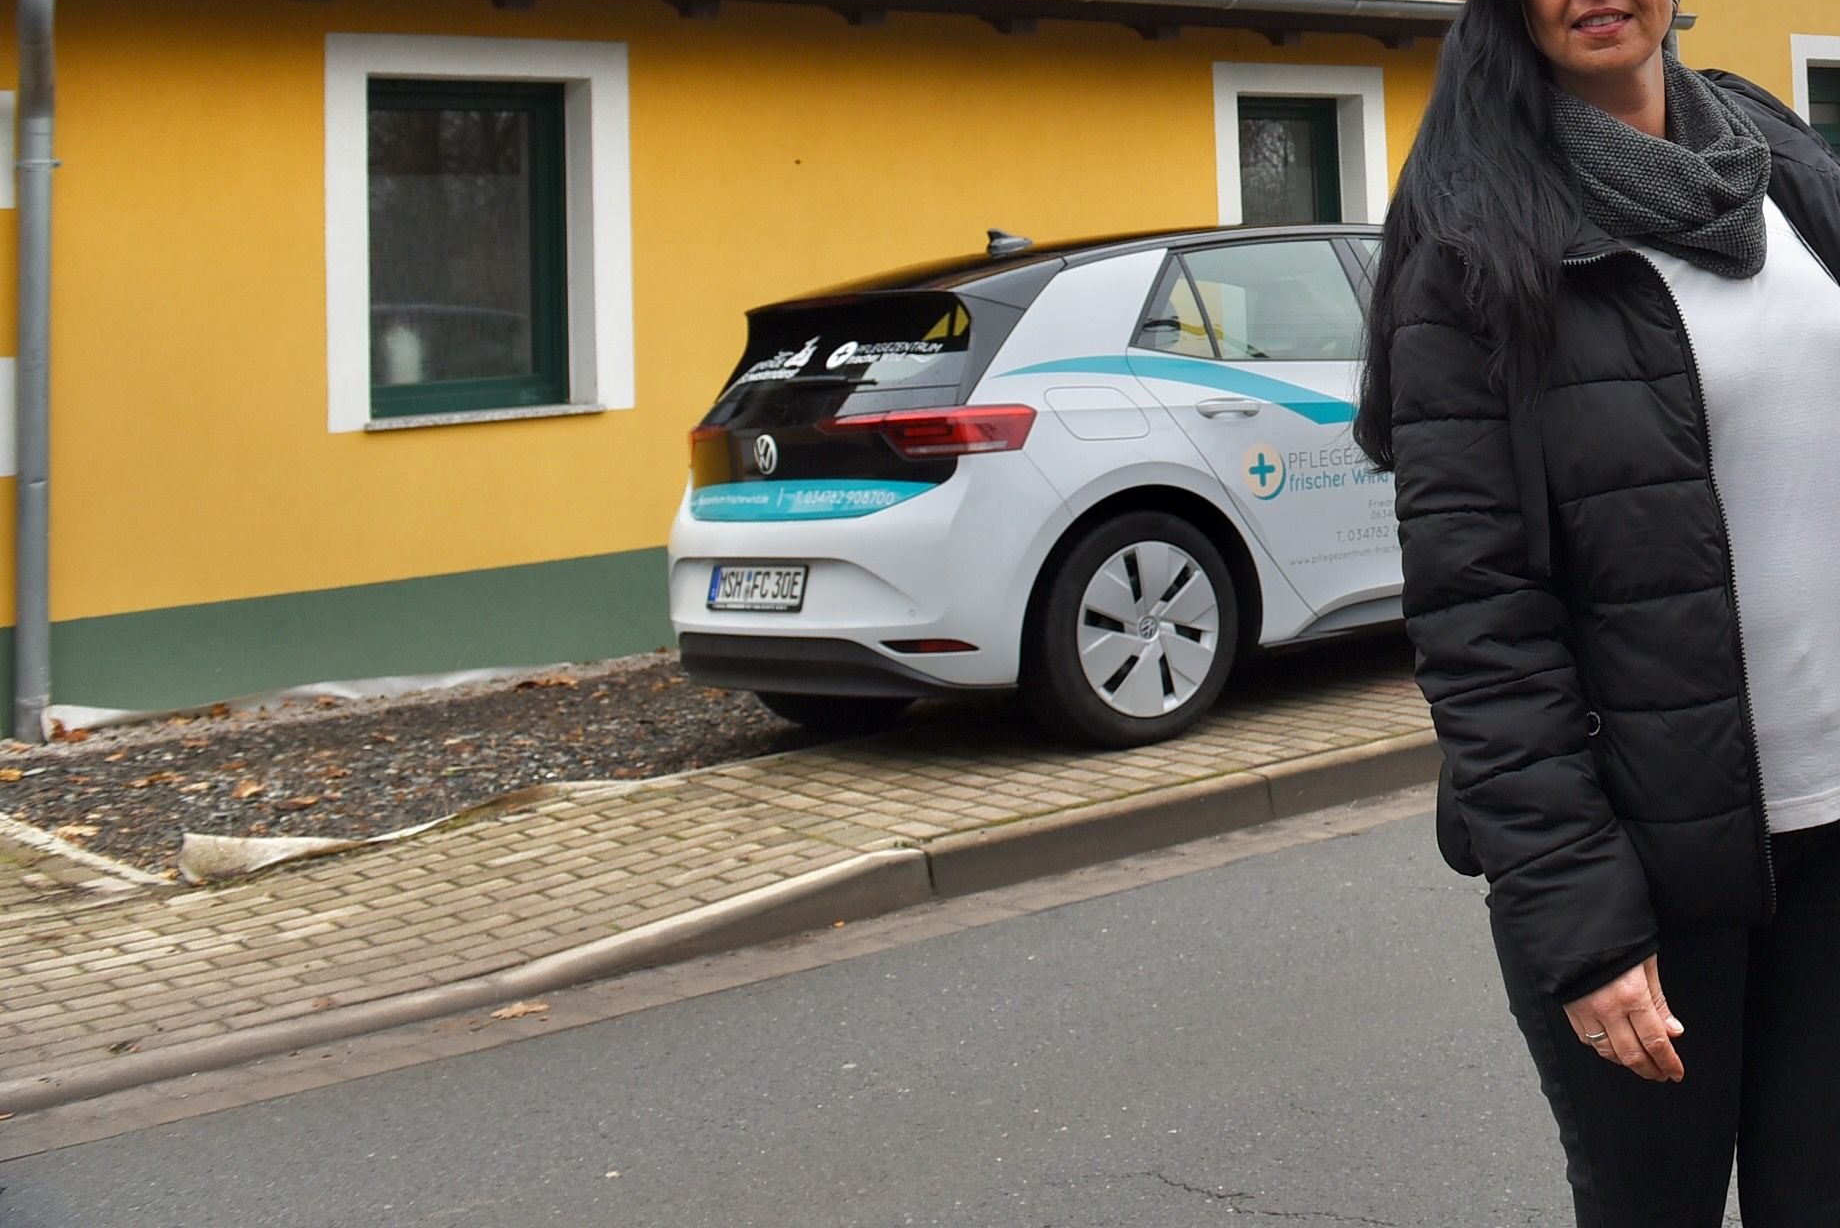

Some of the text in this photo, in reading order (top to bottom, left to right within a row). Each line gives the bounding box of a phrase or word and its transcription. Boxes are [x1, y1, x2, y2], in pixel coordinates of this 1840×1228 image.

[1288, 447, 1367, 469] PFLEGEZ
[1289, 472, 1347, 492] frischer
[1347, 525, 1390, 542] 034782
[716, 571, 802, 600] MSH FC 30E
